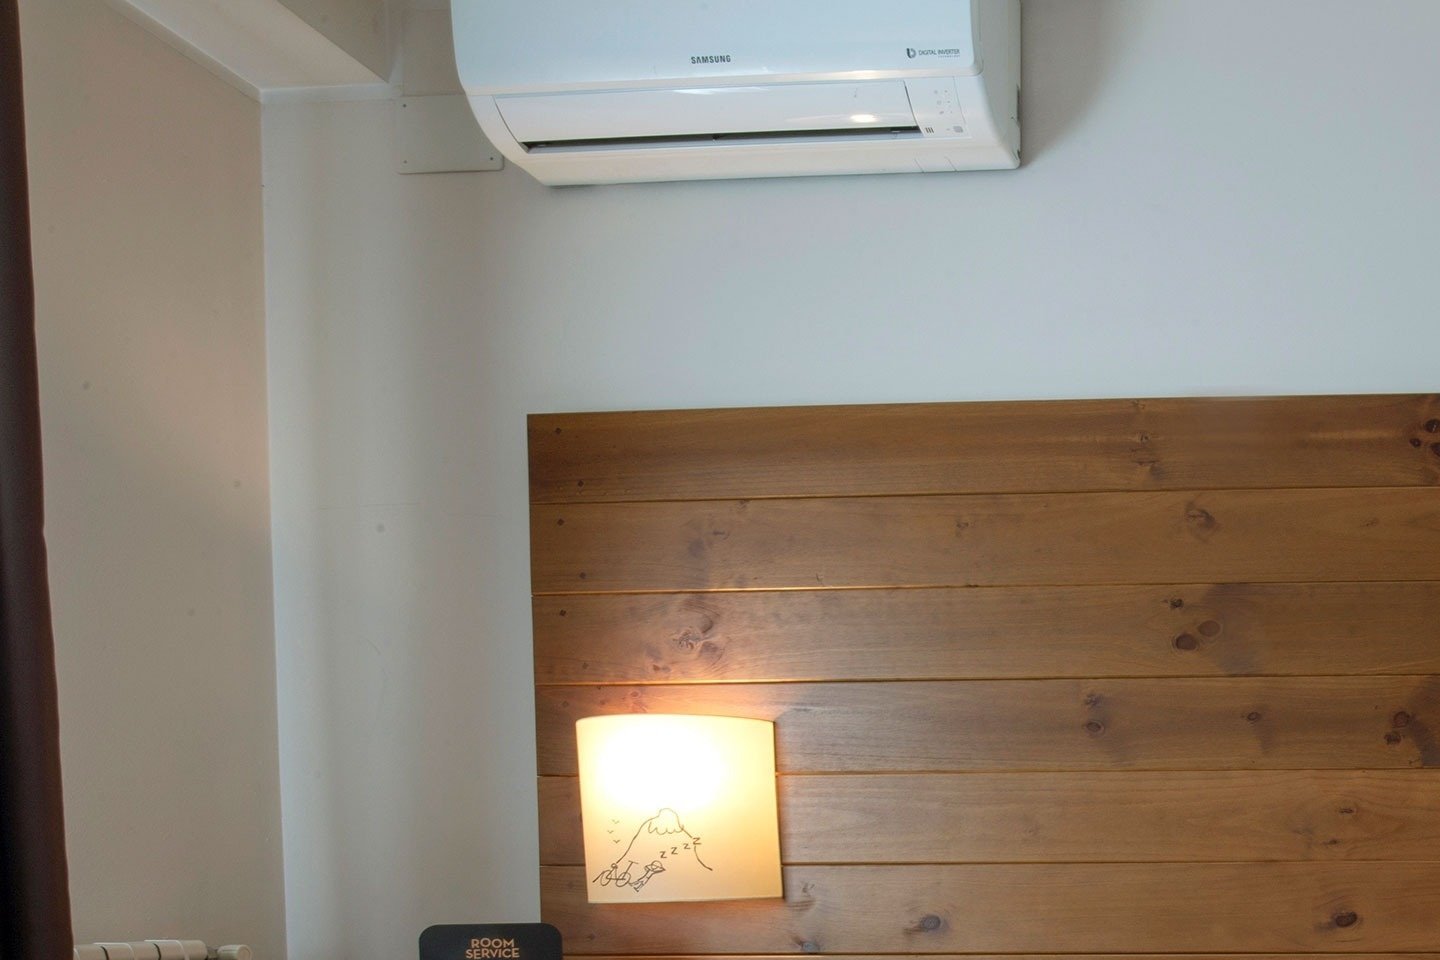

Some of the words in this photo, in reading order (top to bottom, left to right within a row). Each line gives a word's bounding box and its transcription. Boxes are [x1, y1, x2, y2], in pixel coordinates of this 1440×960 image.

[691, 55, 731, 65] SAMSUNG
[471, 938, 514, 948] ROOM
[465, 948, 520, 959] SERVICE
